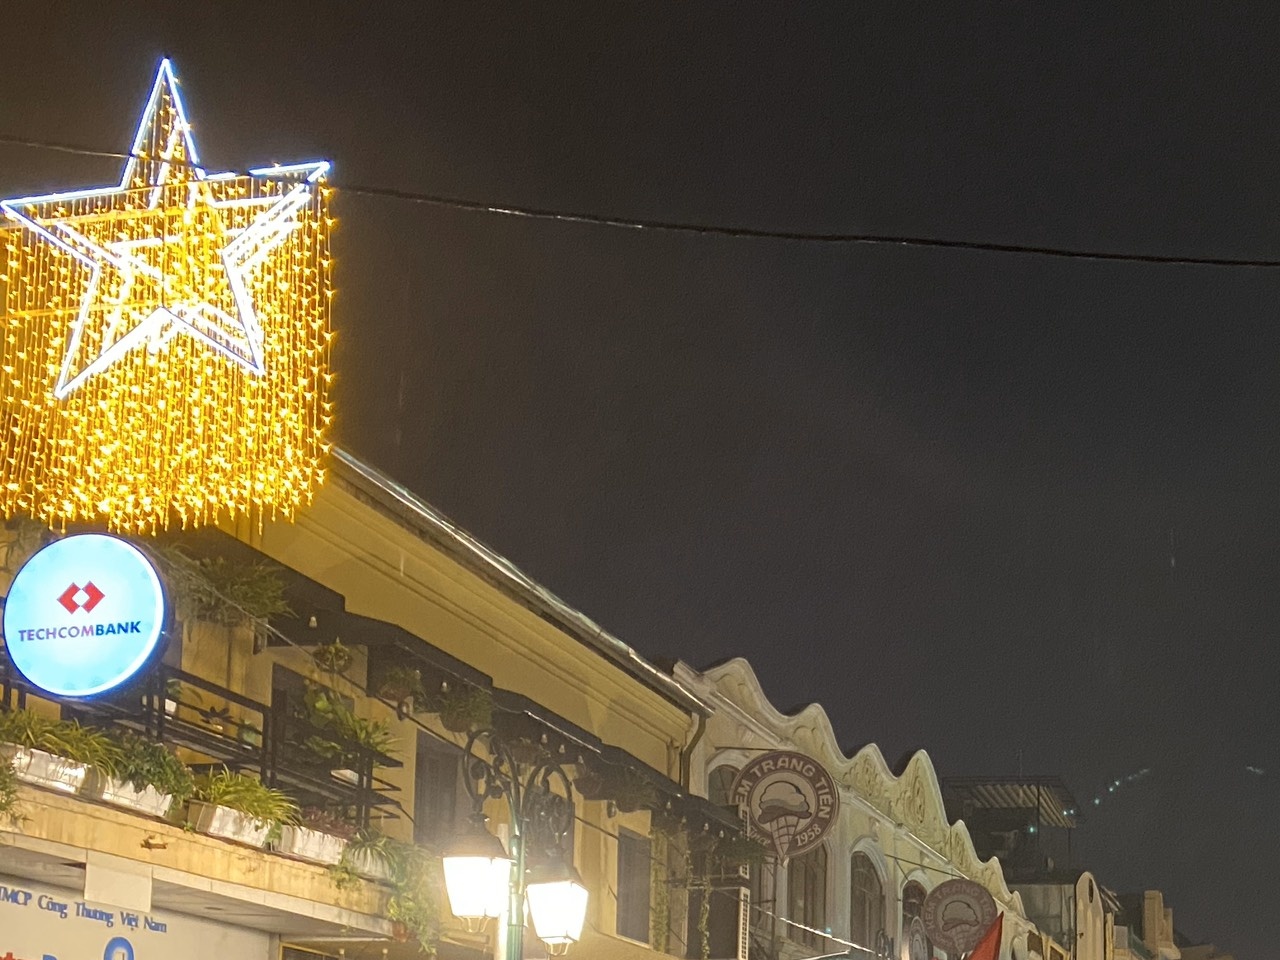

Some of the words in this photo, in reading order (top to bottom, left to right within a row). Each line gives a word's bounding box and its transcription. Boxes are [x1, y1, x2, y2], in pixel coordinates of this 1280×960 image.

[18, 620, 141, 641] TECHCOMBANK
[794, 823, 822, 847] 1958
[143, 915, 168, 933] Nam
